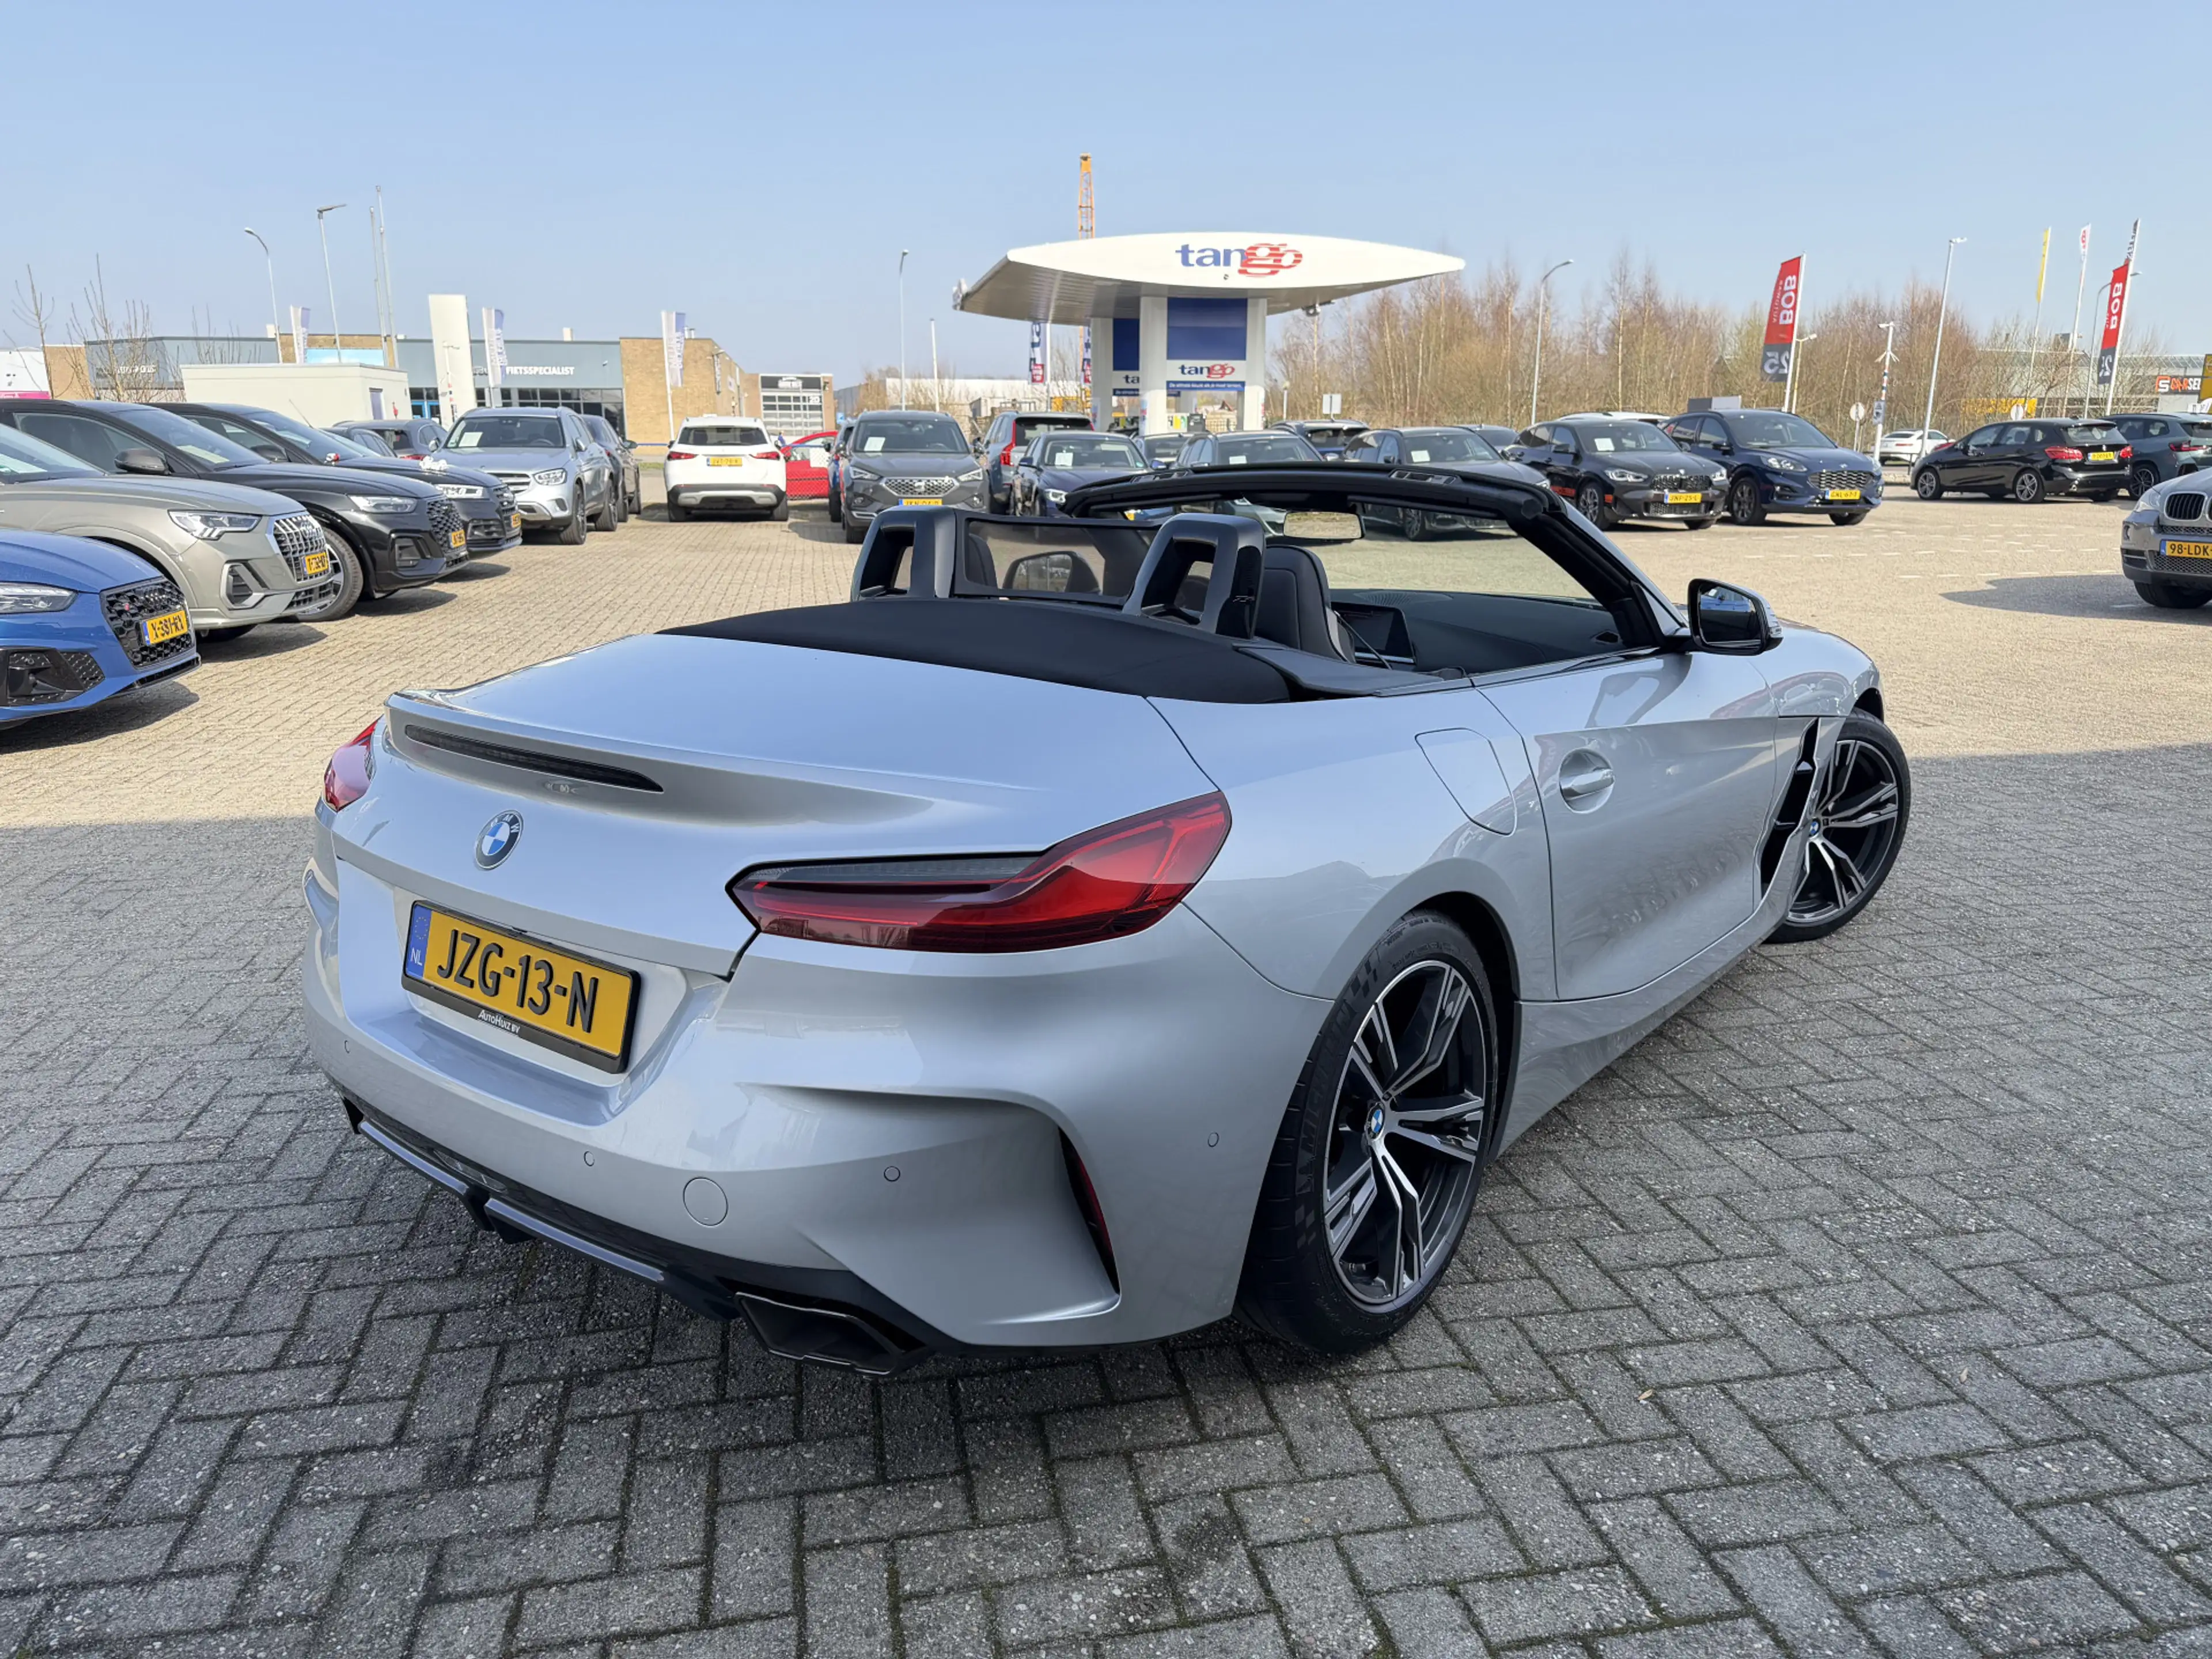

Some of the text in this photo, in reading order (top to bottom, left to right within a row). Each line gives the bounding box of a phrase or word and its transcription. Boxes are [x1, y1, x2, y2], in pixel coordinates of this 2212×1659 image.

[1175, 243, 1302, 278] tango
[506, 366, 574, 375] FIETSSPECIALIST
[1178, 363, 1235, 379] tango
[410, 947, 423, 967] NL
[437, 929, 599, 1033] JZG-13-N
